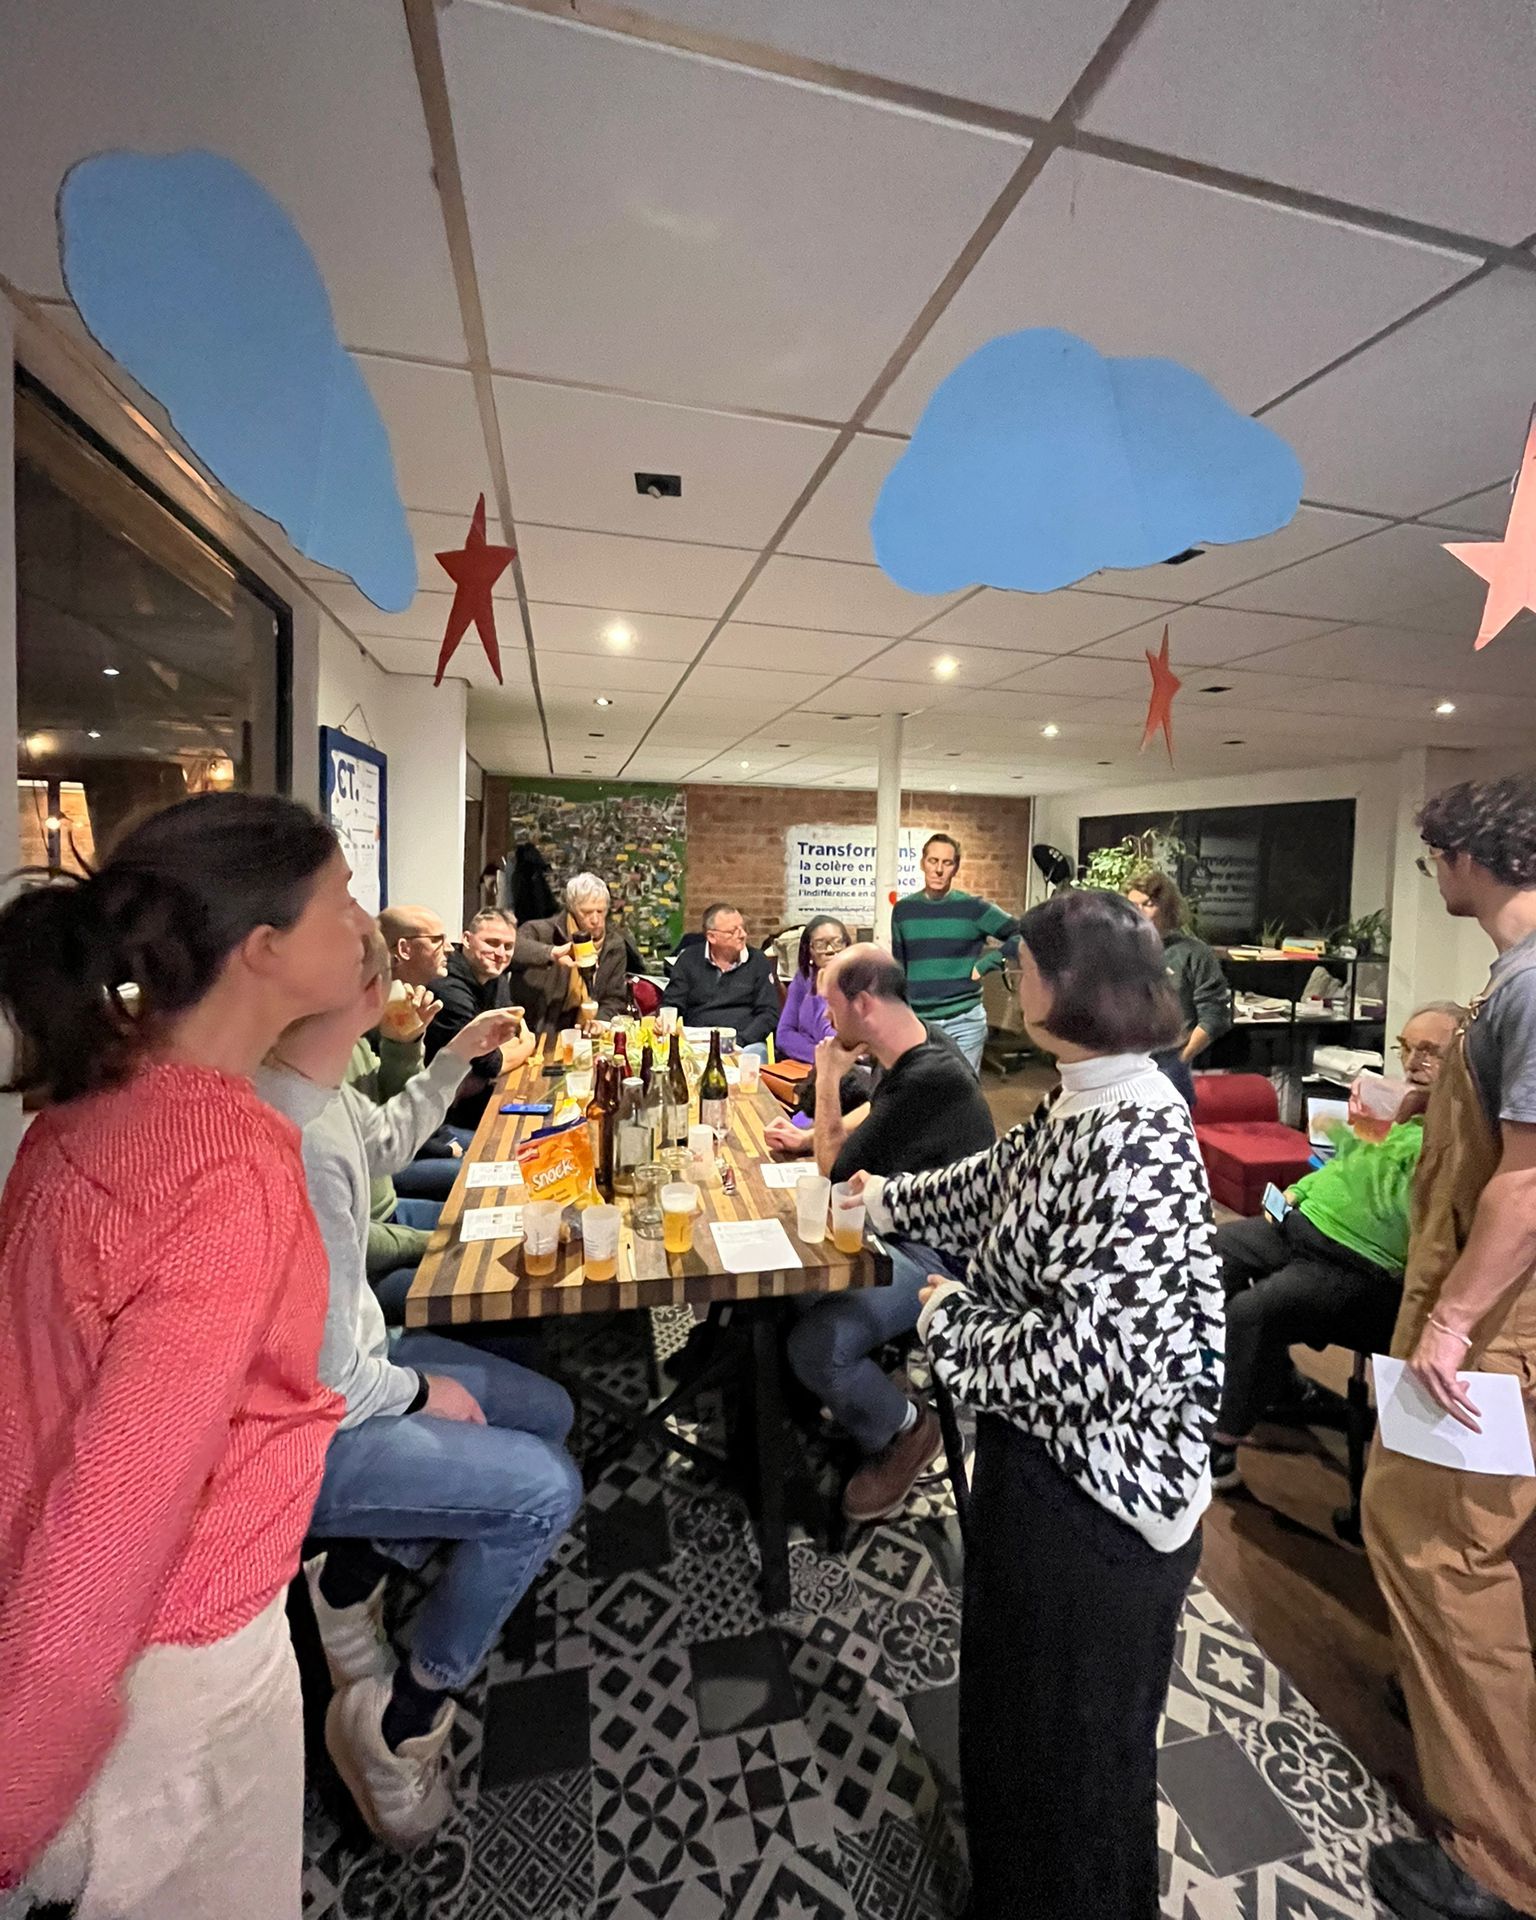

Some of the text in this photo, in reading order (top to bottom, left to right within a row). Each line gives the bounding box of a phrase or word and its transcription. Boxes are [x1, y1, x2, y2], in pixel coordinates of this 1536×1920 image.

[797, 842, 917, 858] Transforns
[799, 860, 811, 871] la
[815, 860, 855, 872] colère
[858, 863, 873, 872] en
[799, 874, 811, 885] la
[815, 876, 846, 887] peur
[850, 877, 866, 886] en
